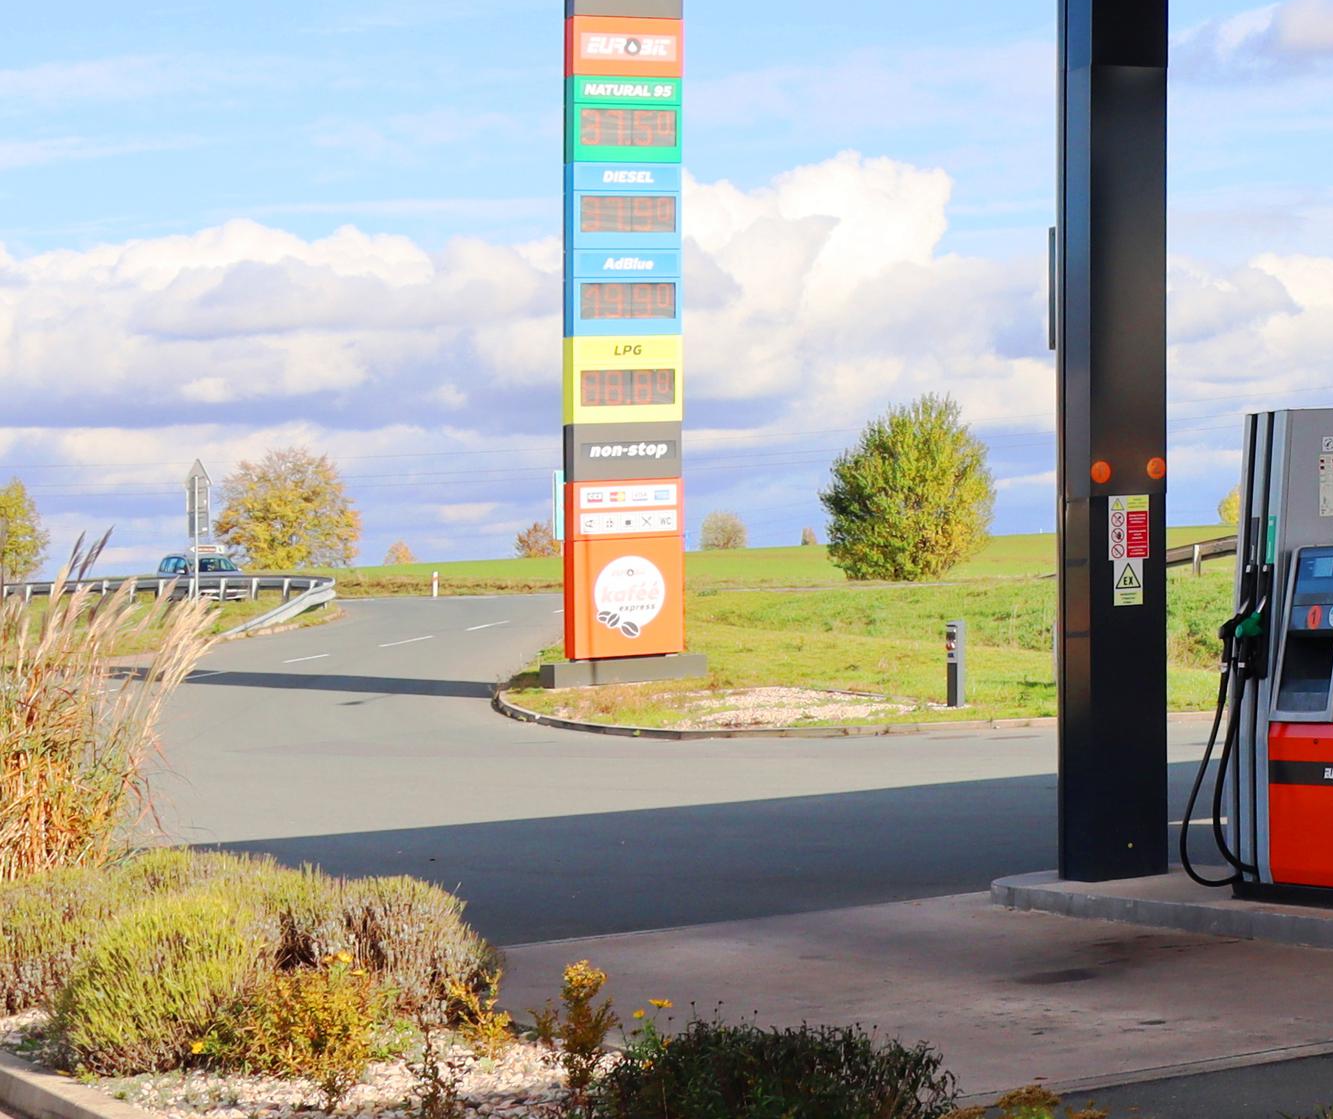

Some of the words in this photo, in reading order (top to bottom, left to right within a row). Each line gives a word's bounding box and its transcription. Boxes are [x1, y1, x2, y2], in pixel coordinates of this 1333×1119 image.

[584, 83, 651, 97] NATURAL
[653, 84, 673, 97] 95
[602, 170, 654, 183] DIESEL
[603, 257, 654, 270] AdBlue
[614, 344, 642, 356] LPG
[589, 442, 668, 459] non-stop
[1123, 576, 1134, 586] EX
[619, 603, 656, 612] express
